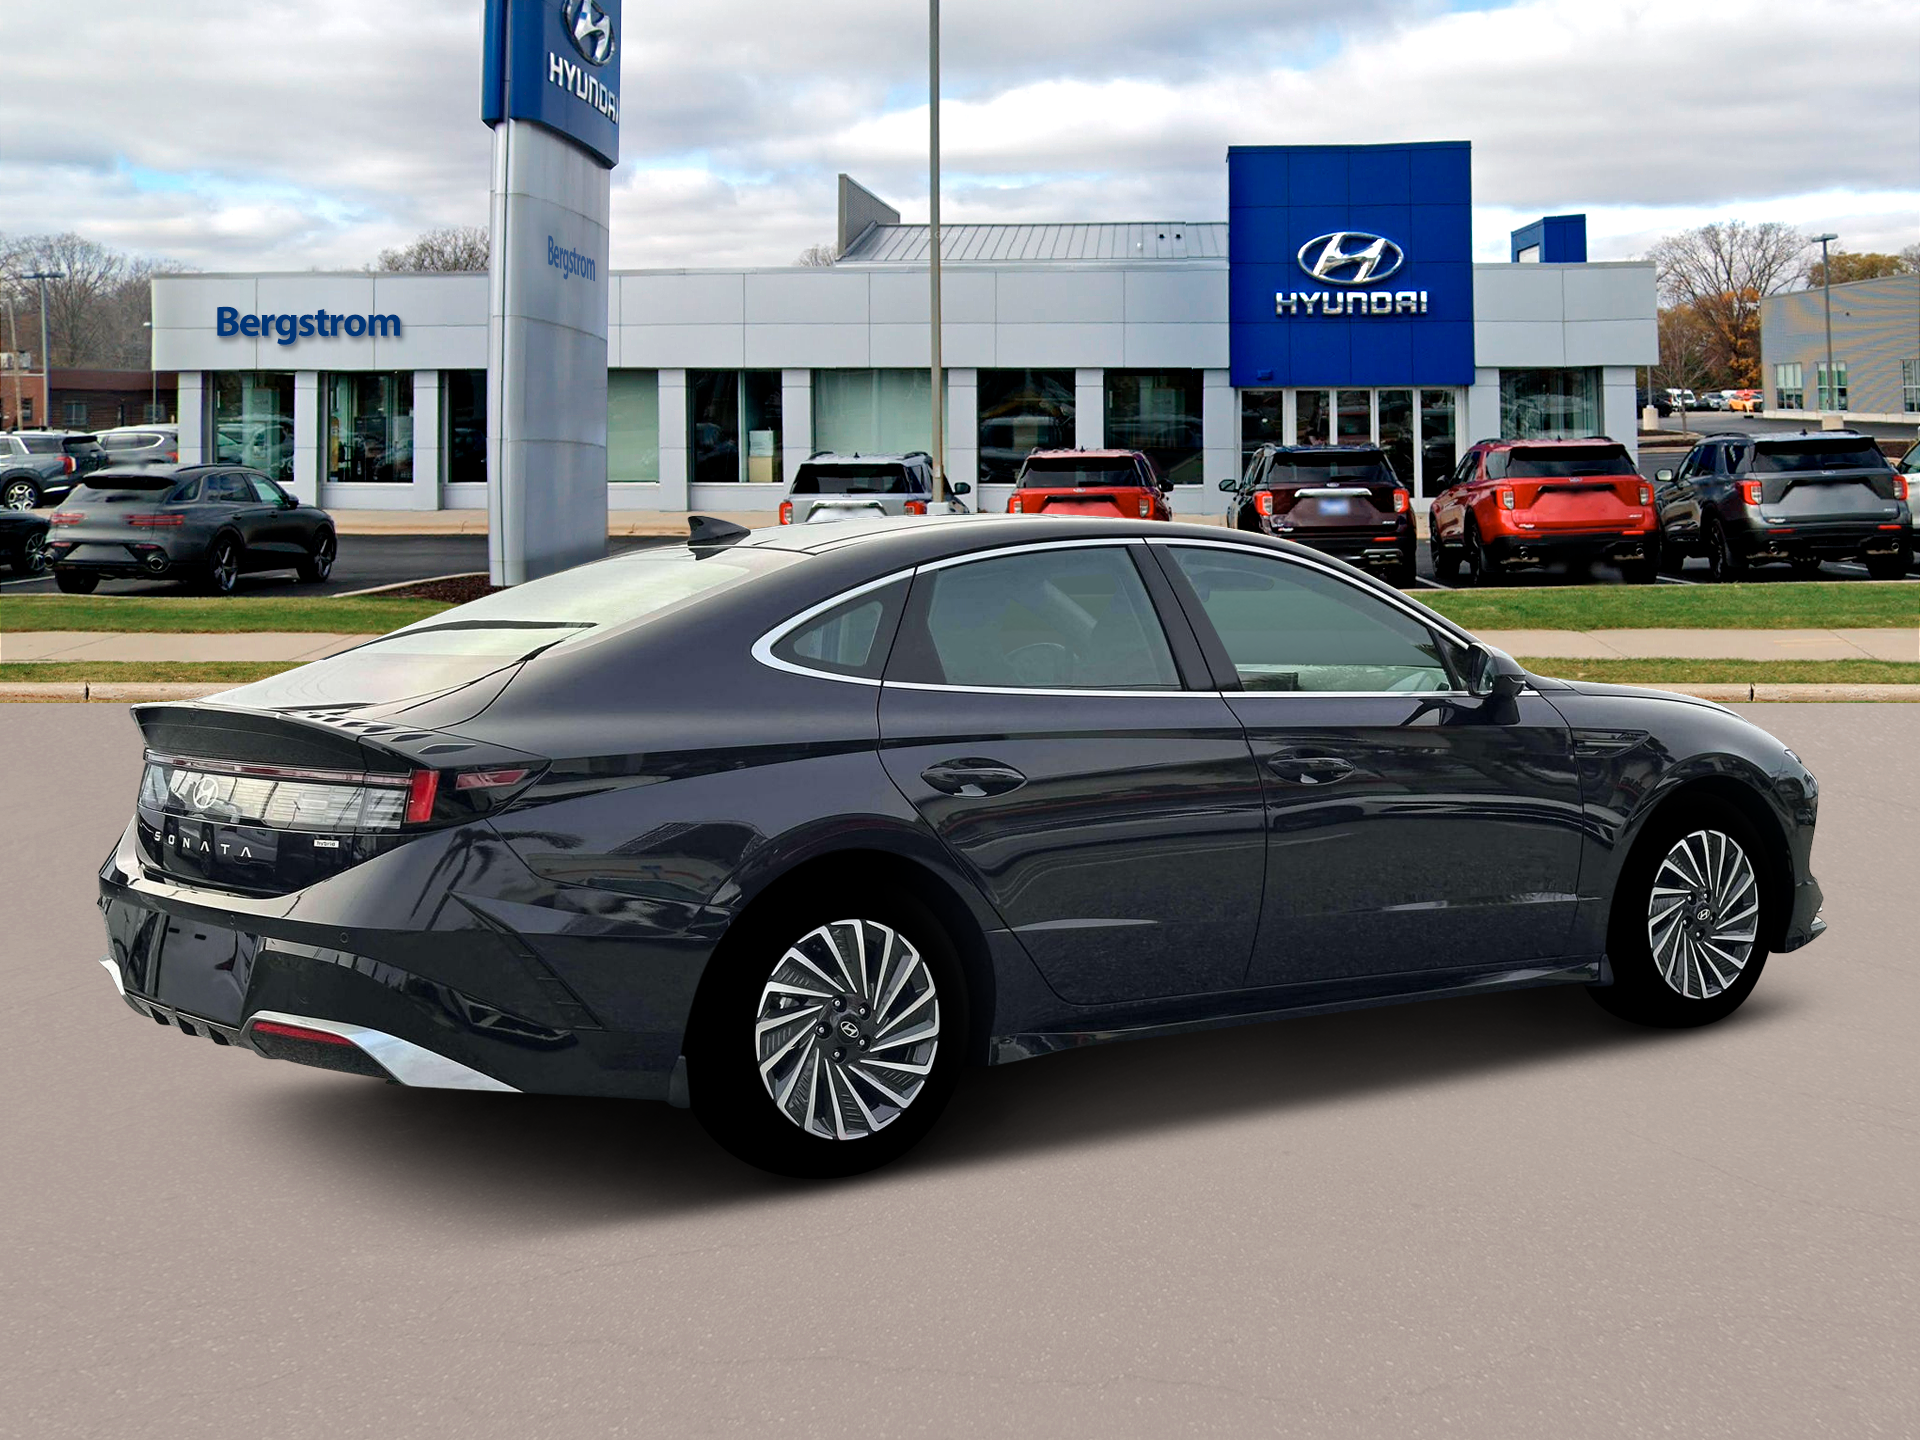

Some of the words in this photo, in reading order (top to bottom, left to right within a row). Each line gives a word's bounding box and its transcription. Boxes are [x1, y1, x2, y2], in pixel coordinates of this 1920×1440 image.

[549, 52, 619, 124] HYUNDAI
[548, 235, 596, 282] Bergstrom
[1275, 291, 1428, 315] HYUNDAI
[216, 306, 401, 346] Bergstrom
[153, 831, 252, 858] SONATA
